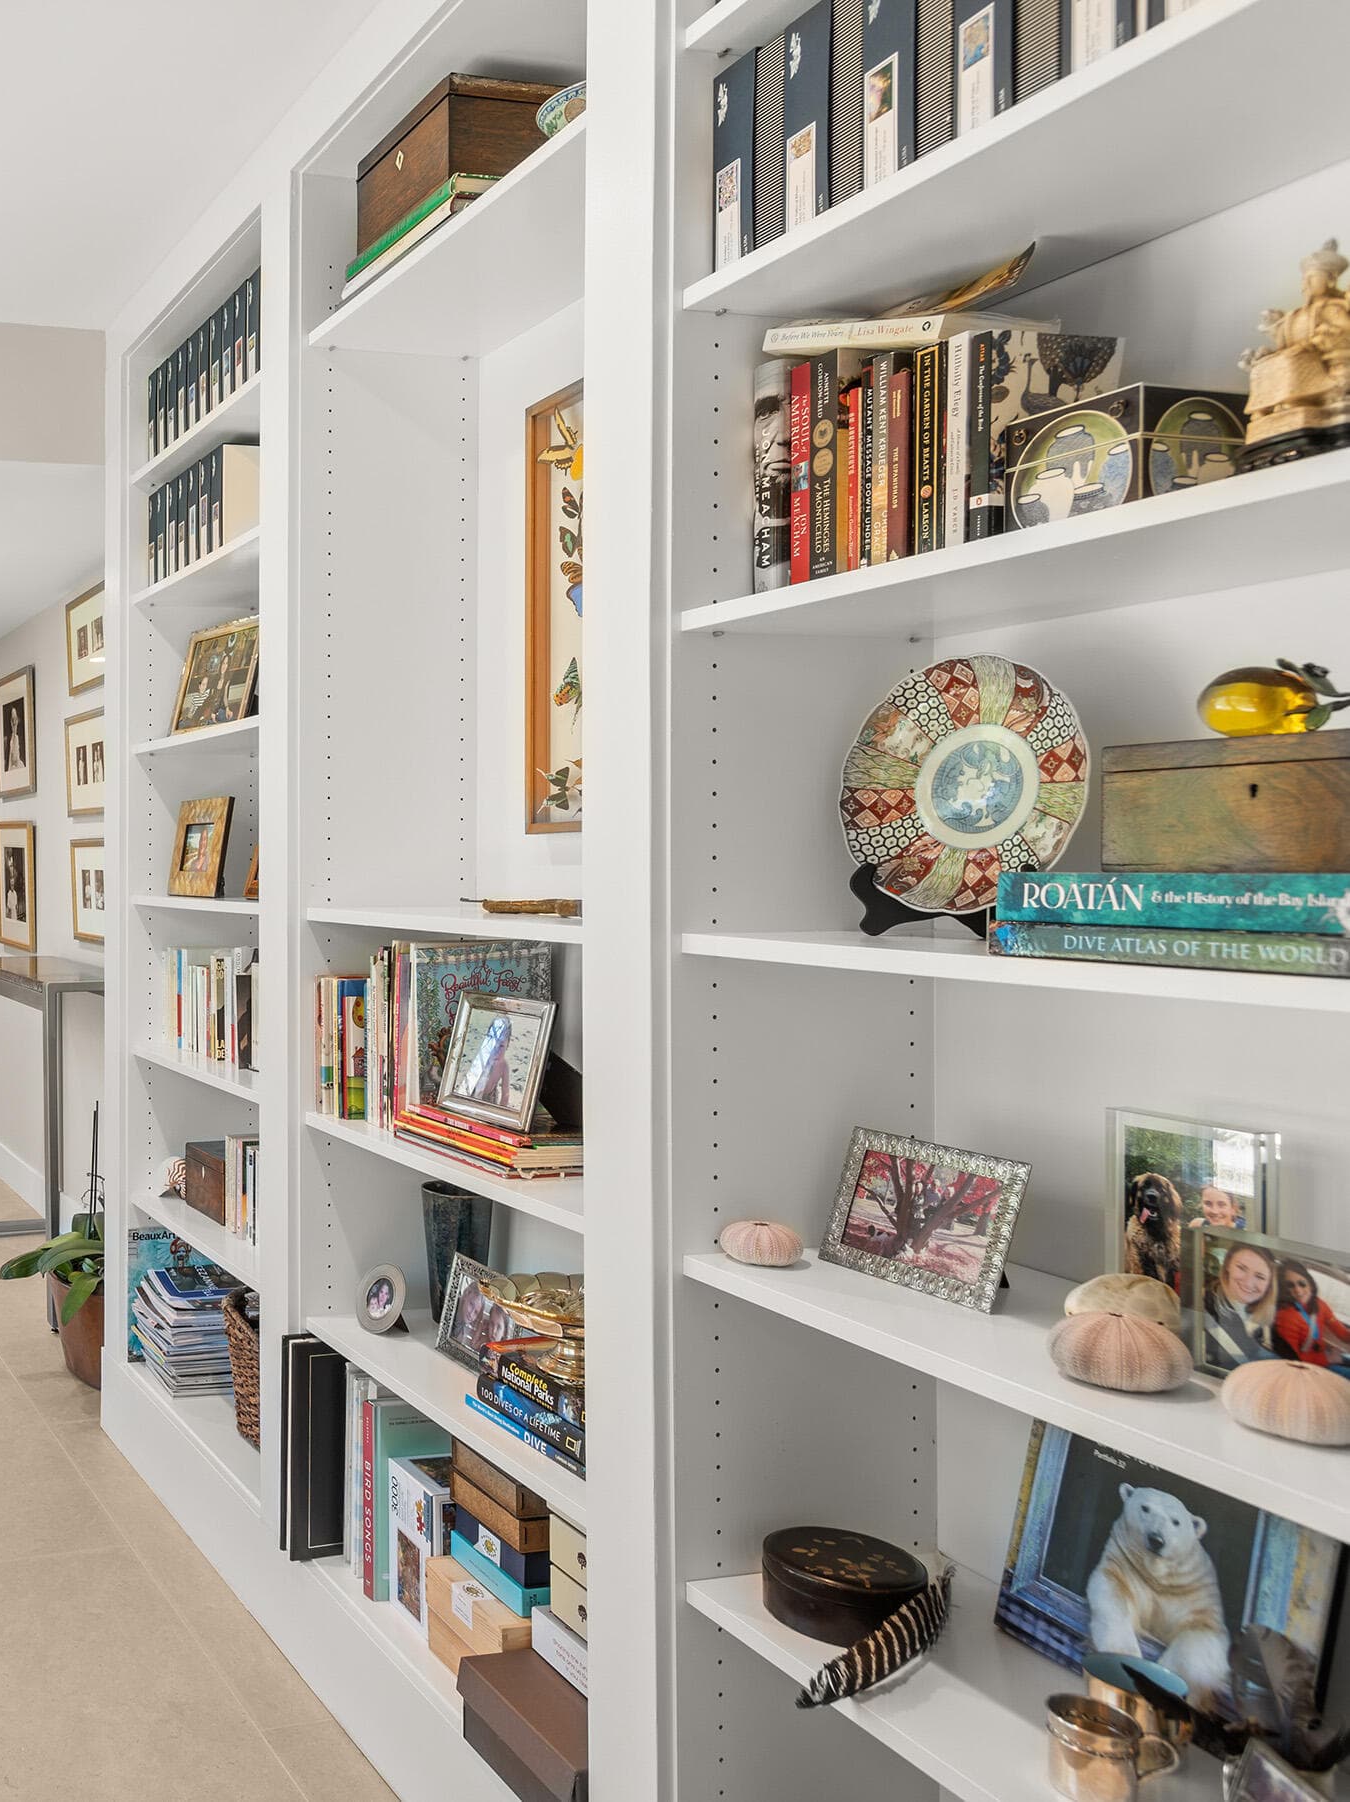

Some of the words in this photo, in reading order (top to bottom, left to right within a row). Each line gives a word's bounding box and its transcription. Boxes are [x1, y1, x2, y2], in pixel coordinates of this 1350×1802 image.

[857, 327, 874, 336] Lisa
[876, 324, 914, 337] Wingate
[924, 355, 931, 366] IN
[954, 343, 963, 387] Hillbilly
[879, 360, 887, 406] WILLIAM
[923, 369, 931, 388] THE
[879, 408, 887, 434] KENT
[923, 390, 931, 430] GARDEN
[952, 389, 962, 418] Elegy
[791, 395, 800, 460] AMERICA
[801, 407, 810, 443] SOUL
[923, 432, 930, 445] OF
[761, 429, 770, 463] JON
[878, 439, 887, 487] KRUEGER
[823, 478, 831, 496] THE
[761, 476, 770, 567] MEACHAM
[793, 497, 801, 557] MEACHAM
[799, 513, 807, 535] JON
[815, 491, 823, 554] MONTICELLO
[823, 499, 831, 553] HEMINGSES
[873, 521, 881, 556] GRACE
[922, 502, 930, 540] LARSON
[1022, 877, 1144, 912] ROATÁN
[1151, 891, 1163, 903] &
[1164, 891, 1186, 904] the
[1187, 892, 1235, 908] History
[1236, 892, 1252, 905] of
[1253, 892, 1276, 905] the
[1278, 893, 1303, 910] Bay
[1063, 935, 1106, 952] DIVE
[1110, 936, 1167, 956] ATLAS
[1173, 939, 1201, 957] OF
[1205, 941, 1250, 960] THE
[1256, 943, 1349, 966] WORLD
[441, 967, 491, 1000] Beautiful
[490, 969, 527, 993] Feast
[501, 1365, 532, 1394] National
[533, 1384, 554, 1406] Parks
[509, 1362, 548, 1391] Complete
[481, 1386, 494, 1401] 100
[494, 1395, 513, 1413] DIVES
[513, 1407, 523, 1418] OF
[523, 1413, 529, 1423] A
[529, 1416, 562, 1442] LIFETIME
[523, 1431, 547, 1455] DIVE
[364, 1460, 372, 1501] BIRD
[364, 1507, 372, 1563] SONGS
